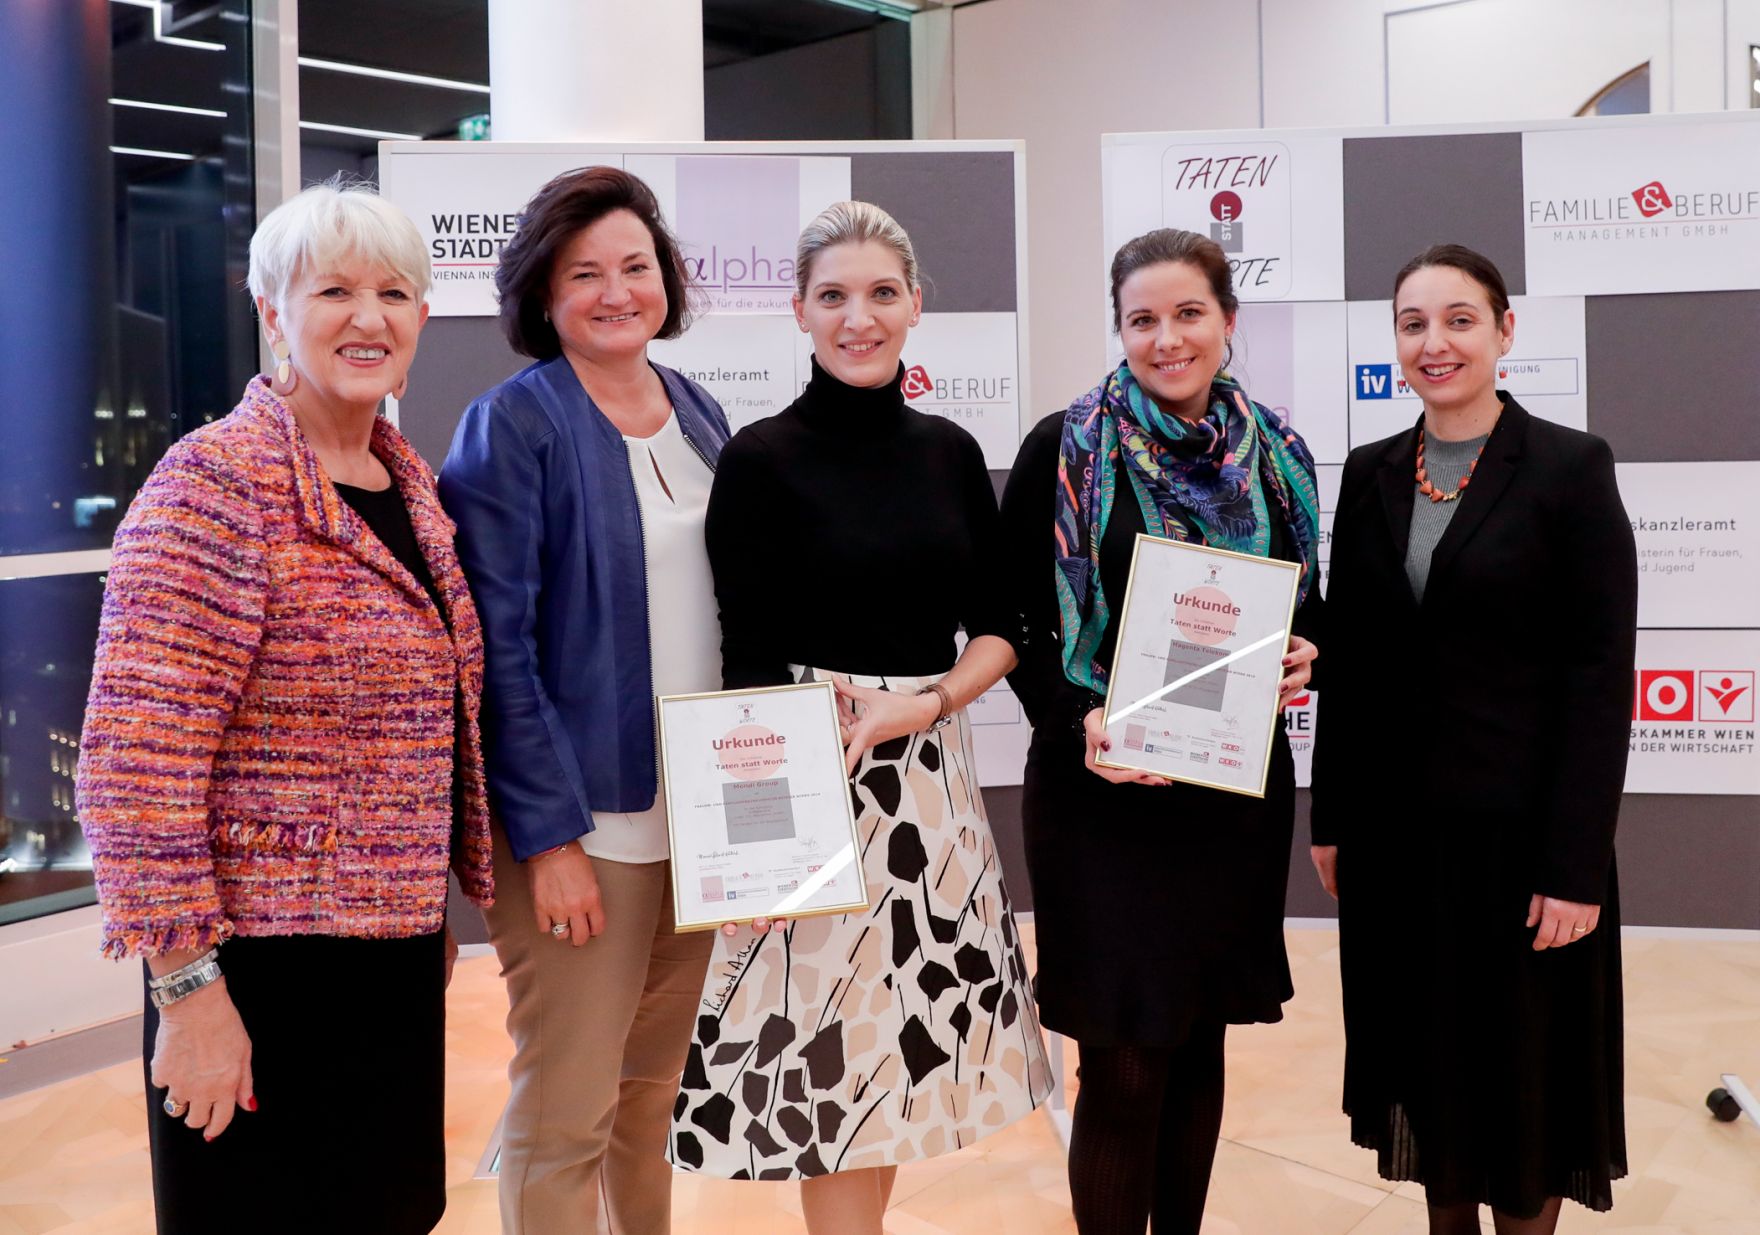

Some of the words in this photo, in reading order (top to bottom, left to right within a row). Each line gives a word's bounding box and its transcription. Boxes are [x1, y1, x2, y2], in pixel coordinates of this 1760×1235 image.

[1176, 154, 1278, 190] TATEN
[1530, 197, 1630, 223] FAMILIE
[1675, 192, 1759, 218] BERUF
[1221, 203, 1232, 241] STATT
[1553, 227, 1669, 241] MANAGEMENT
[1682, 224, 1729, 238] GMBH
[433, 271, 475, 280] VIENNA
[717, 297, 732, 309] für
[736, 297, 753, 309] die
[936, 377, 1011, 400] BERUF
[1361, 368, 1386, 395] iv
[735, 396, 776, 408] Frauen,
[942, 407, 984, 418] GMBH
[1679, 547, 1695, 558] für
[1699, 547, 1743, 559] Frauen,
[1652, 563, 1695, 575] Jugend
[1173, 592, 1241, 616] Urkunde
[1170, 618, 1192, 629] Taten
[1193, 623, 1212, 632] statt
[1213, 626, 1237, 637] Worte
[712, 733, 787, 751] Urkunde
[1714, 730, 1755, 740] WIEN
[1641, 743, 1666, 752] DER
[1670, 743, 1754, 754] WIRTSCHAFT
[715, 762, 739, 771] Taten
[741, 759, 761, 769] statt
[763, 757, 788, 767] Worte
